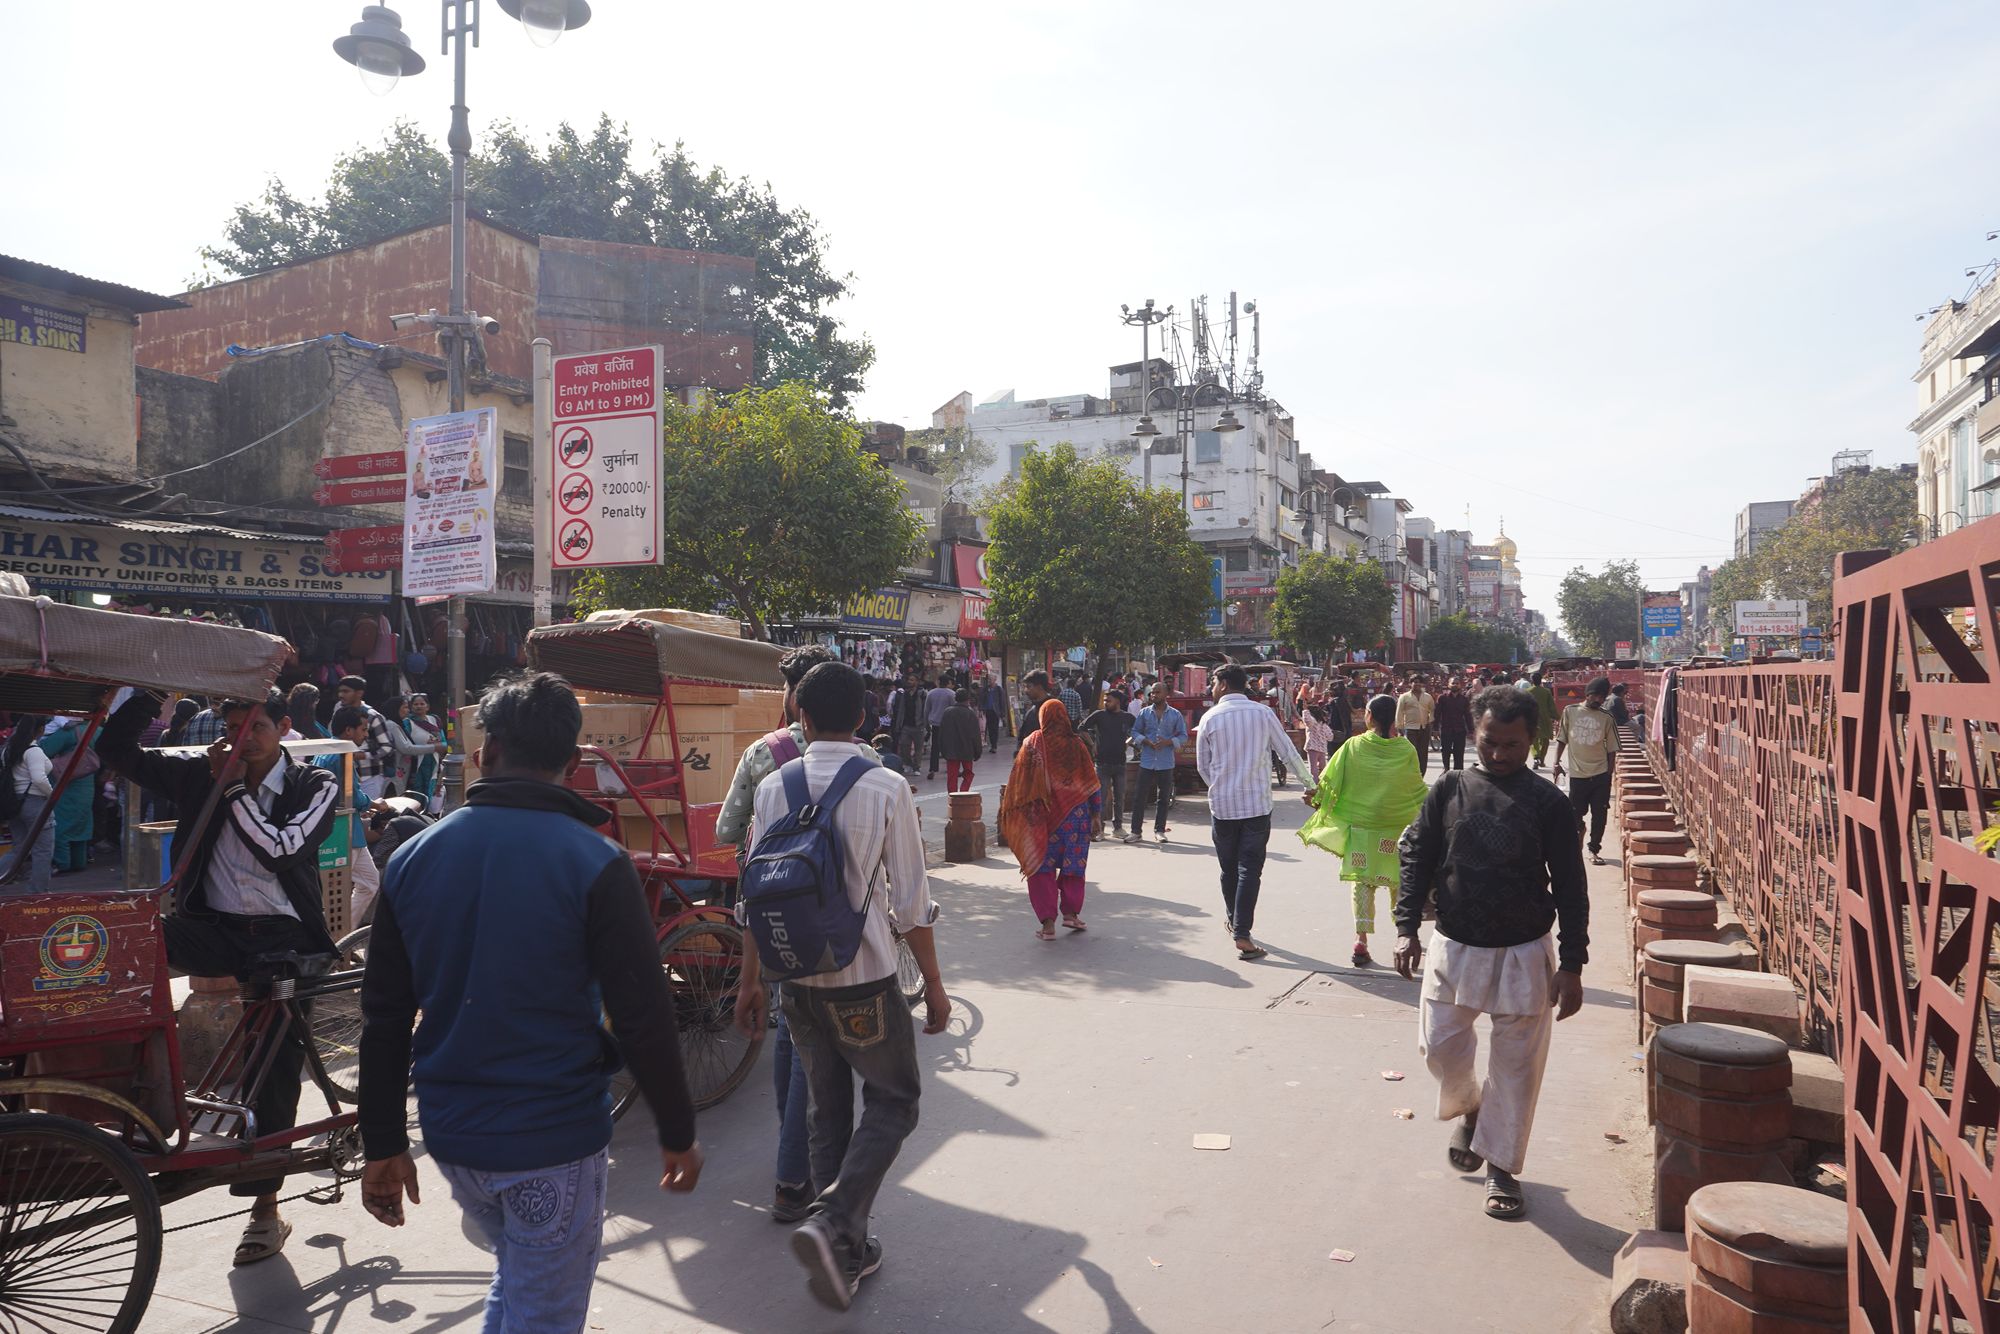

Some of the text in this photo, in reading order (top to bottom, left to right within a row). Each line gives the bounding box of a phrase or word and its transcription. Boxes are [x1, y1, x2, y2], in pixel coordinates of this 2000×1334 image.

[20, 325, 33, 346] &
[36, 325, 80, 352] SONS
[574, 355, 635, 377] प्रवेश वर्जित
[560, 375, 649, 397] Entry Prohibited
[559, 392, 650, 416] (9 AM to 9 PM)
[602, 450, 639, 472] जुर्माना
[351, 486, 404, 498] Ghadi Market
[602, 480, 651, 496] ₹20000/-
[602, 505, 646, 519] Penalty
[119, 541, 242, 573] SINGH
[260, 554, 283, 574] &
[0, 560, 343, 590] SECURITY UNIFORMS & BAGS ITEMS
[40, 578, 69, 587] MOTI
[71, 580, 114, 590] CINEMA,
[117, 583, 145, 592] NEAR
[147, 585, 178, 593] GAURI
[225, 588, 261, 597] MANDIR,
[263, 590, 300, 598] CHANDNI
[302, 591, 333, 599] CHOWK,
[760, 868, 789, 882] safari
[23, 906, 50, 915] WARD
[57, 905, 97, 914] CHANDNI
[99, 903, 130, 912] CHOWK
[762, 911, 803, 970] safari
